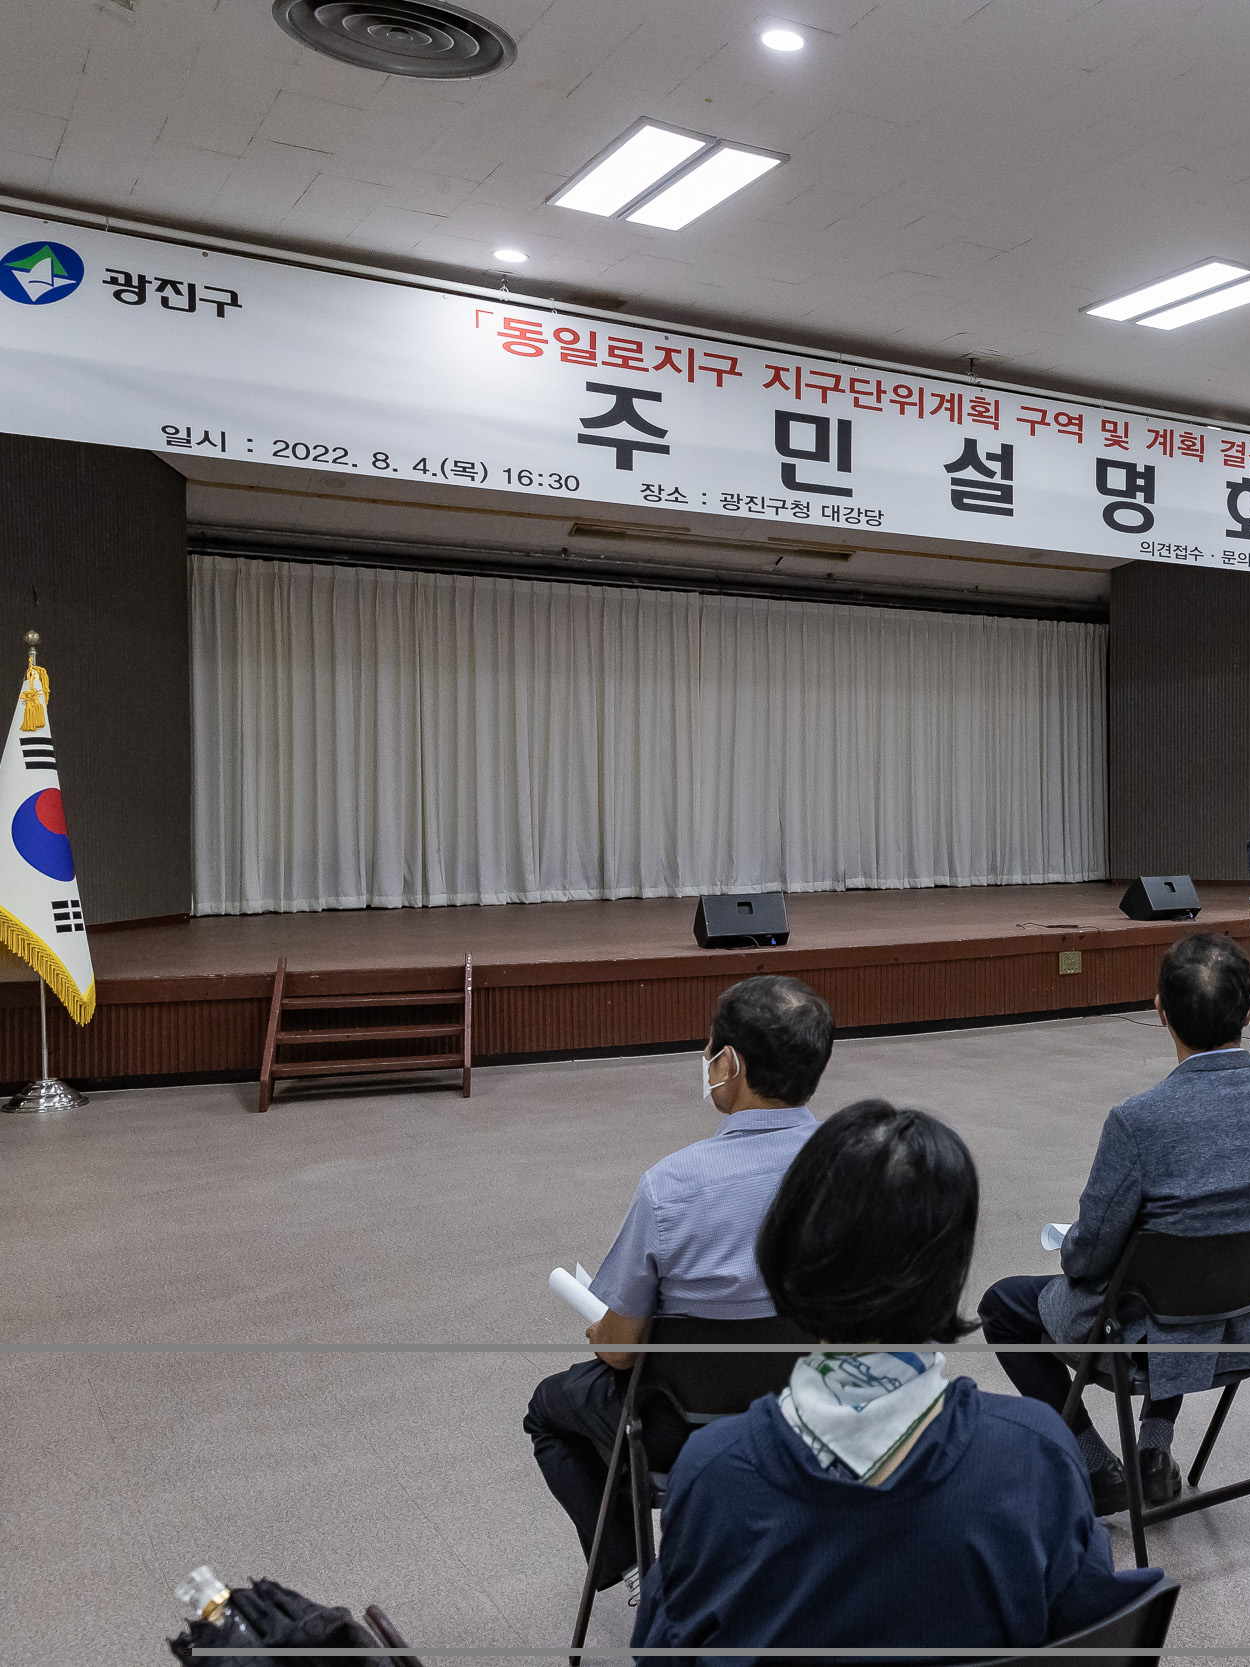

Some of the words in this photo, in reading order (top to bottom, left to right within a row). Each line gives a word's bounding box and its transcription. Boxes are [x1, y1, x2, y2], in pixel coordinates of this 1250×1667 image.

[102, 267, 243, 319] 광진구
[762, 363, 1000, 431] 지구단위계획
[1016, 405, 1084, 444] 구역
[1101, 418, 1129, 449] 및
[1146, 427, 1205, 463] 계획
[160, 424, 228, 453] 일시
[271, 438, 359, 468] 2022.
[370, 450, 399, 472] 8.
[411, 456, 489, 484] 4.(목)
[502, 466, 581, 492] 16:30
[639, 482, 690, 506] 장소
[719, 491, 812, 520] 광진구청
[821, 504, 885, 528] 대강당
[1139, 540, 1205, 562] 의견접수
